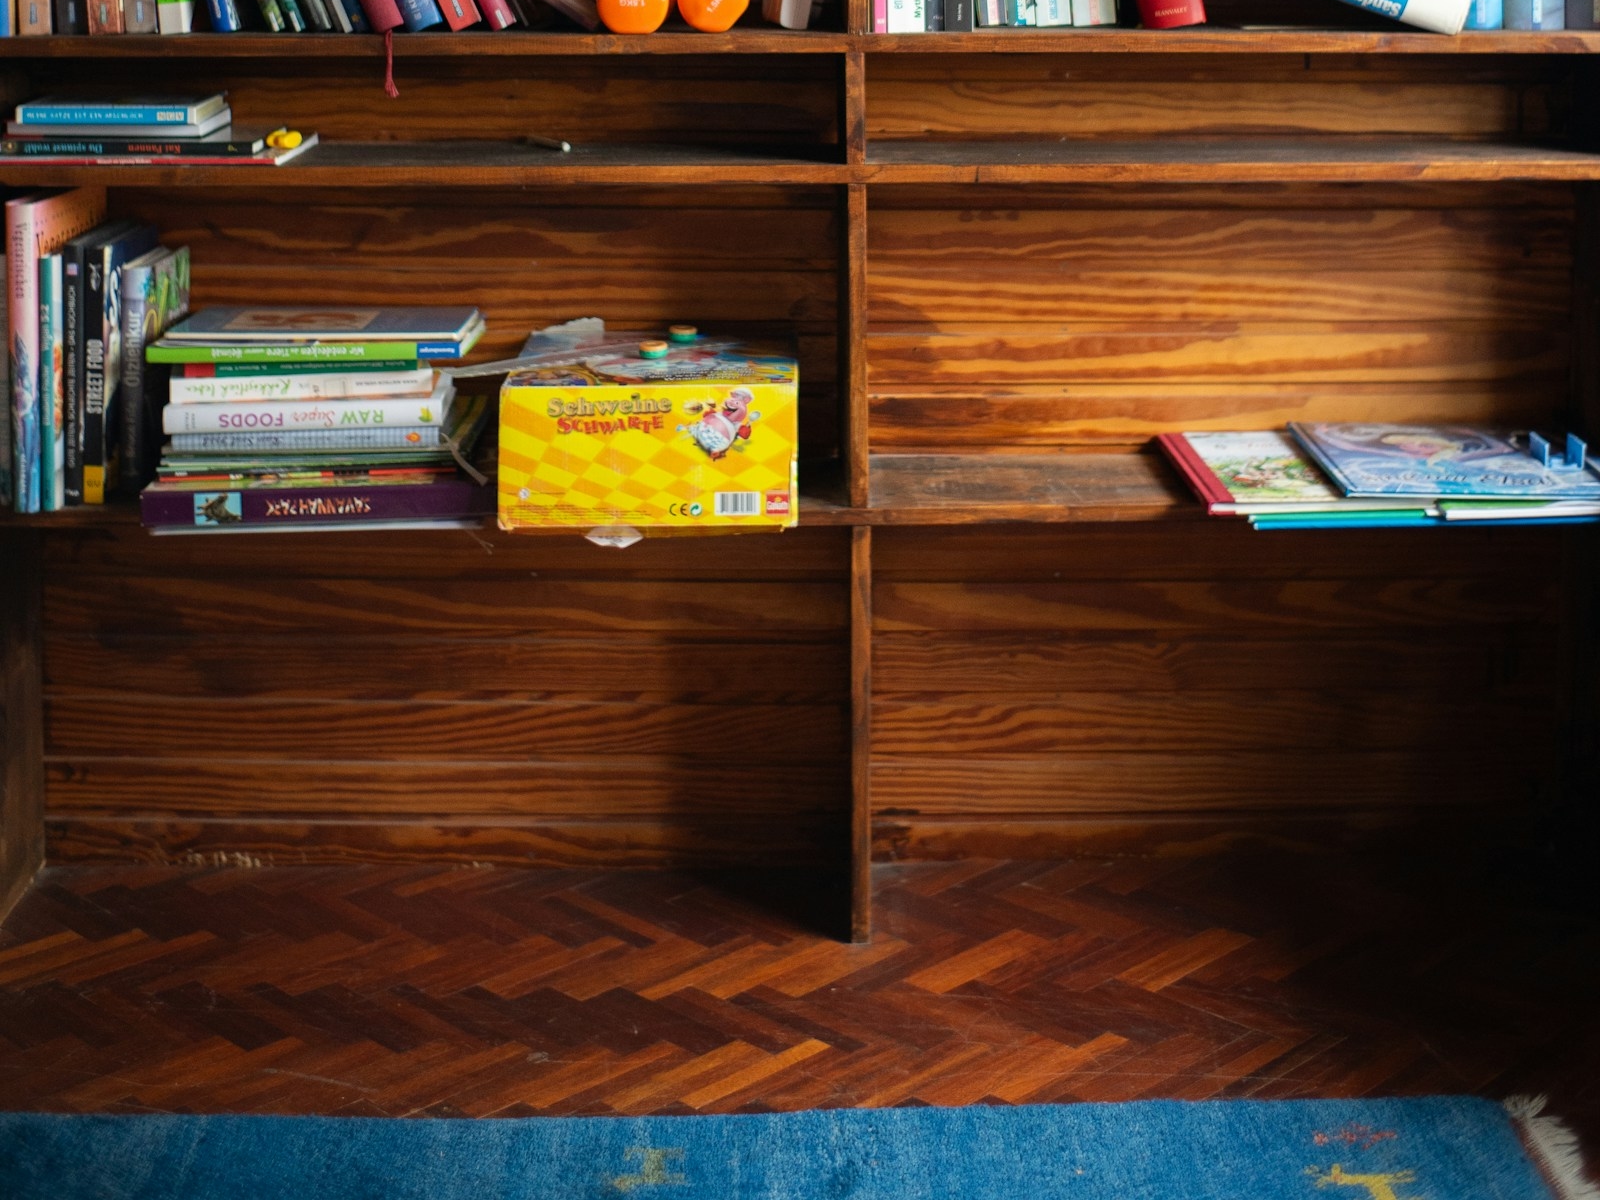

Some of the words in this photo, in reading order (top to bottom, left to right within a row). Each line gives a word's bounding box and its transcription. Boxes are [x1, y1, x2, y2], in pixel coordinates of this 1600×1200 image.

[86, 338, 104, 368] FOOD
[122, 309, 142, 388] Ölziehkur
[300, 345, 347, 357] entdecken
[348, 345, 364, 356] Wir
[86, 371, 103, 415] STREET
[548, 393, 672, 418] Schweine
[218, 412, 283, 426] FOODS
[291, 407, 334, 426] Super
[340, 410, 383, 424] RAW
[556, 415, 664, 436] SCHWARTE
